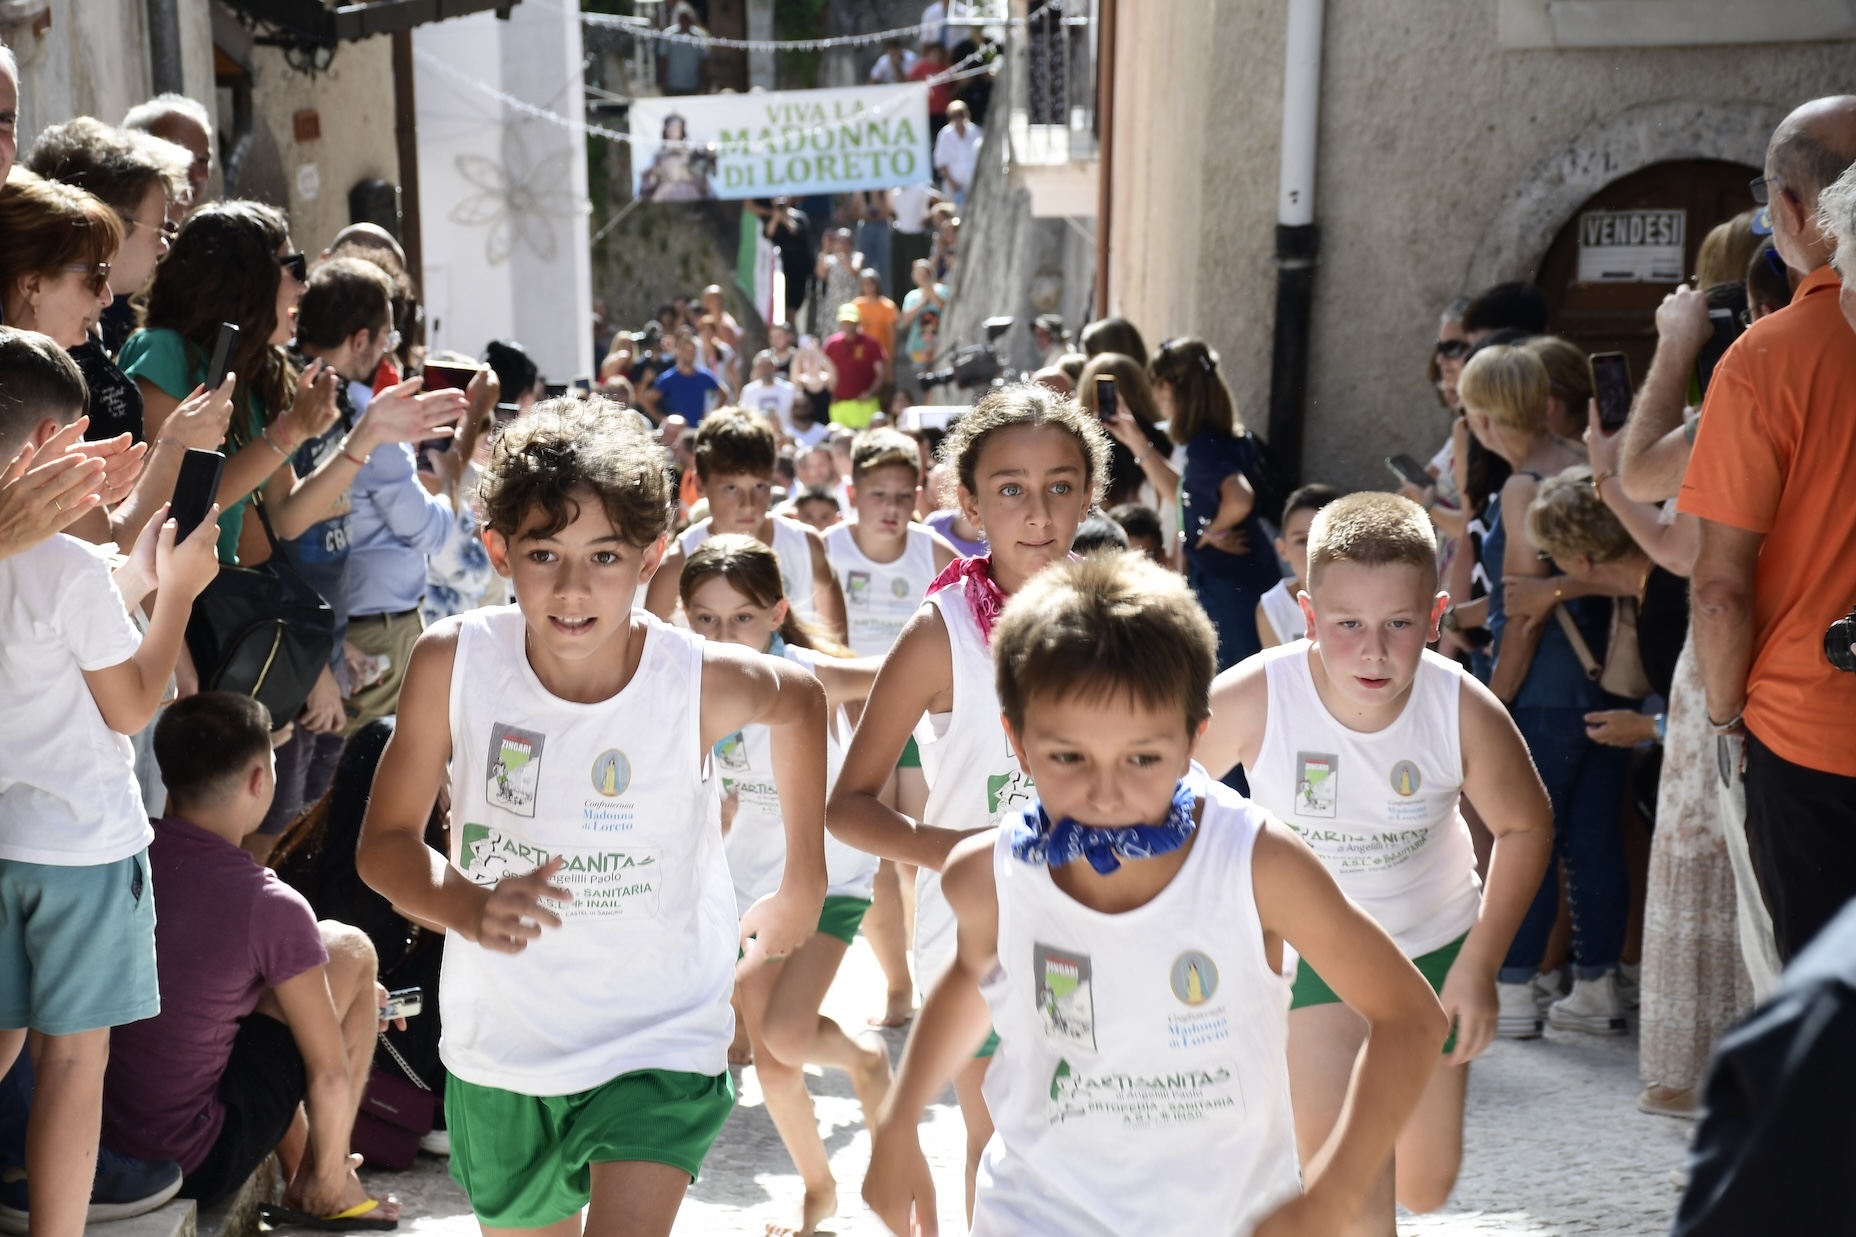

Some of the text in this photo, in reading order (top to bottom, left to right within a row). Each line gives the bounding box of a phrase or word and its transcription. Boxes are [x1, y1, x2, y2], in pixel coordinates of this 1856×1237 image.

[766, 100, 865, 125] VIVA LA
[718, 117, 918, 157] MADONNA
[724, 149, 915, 189] DI LORETO
[1585, 216, 1680, 244] VENDESI
[502, 738, 532, 755] ZINGARI
[583, 809, 634, 820] Madonna
[593, 820, 633, 831] Loreto
[591, 872, 622, 884] Paolo
[584, 882, 652, 898] SANITARIA
[587, 899, 621, 908] INAIL
